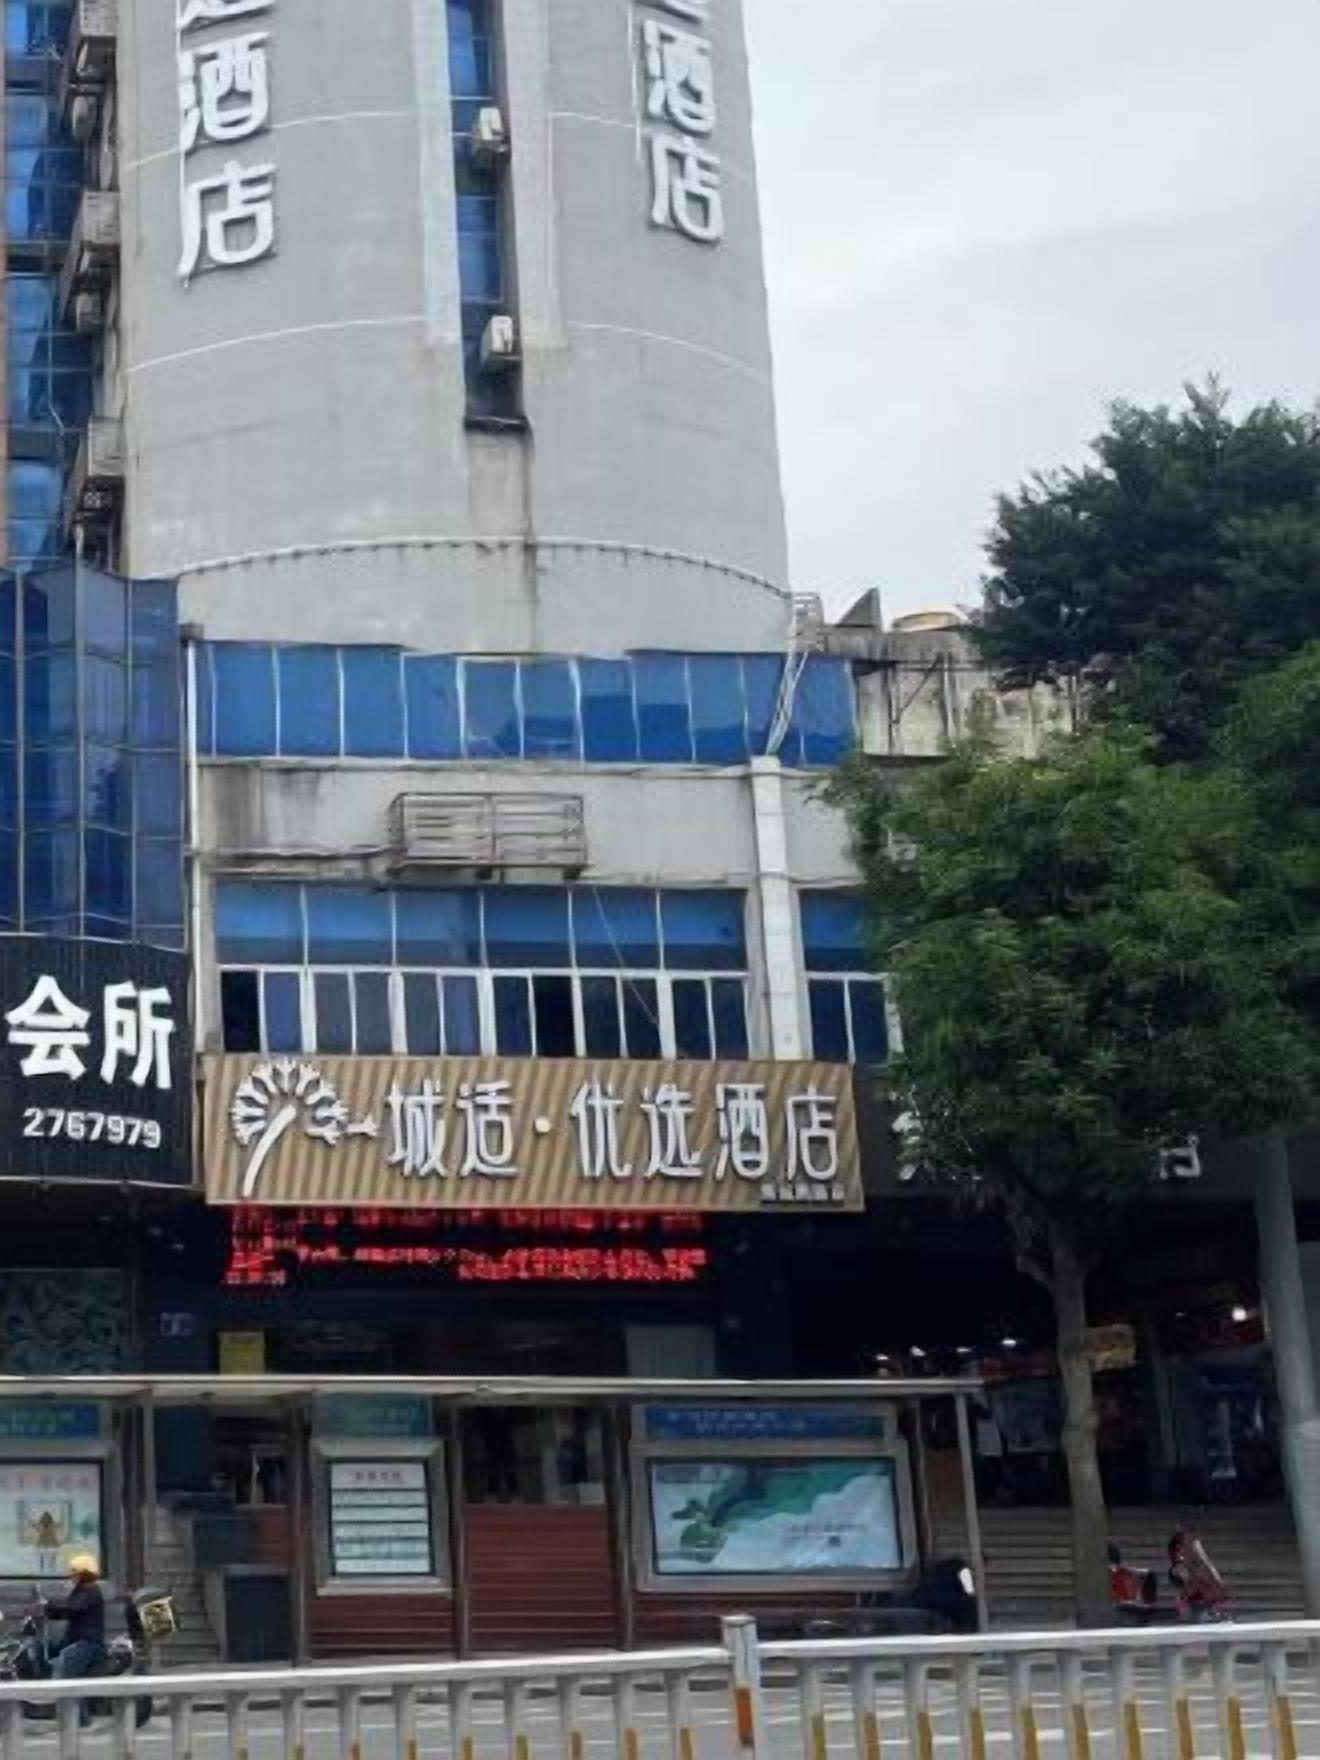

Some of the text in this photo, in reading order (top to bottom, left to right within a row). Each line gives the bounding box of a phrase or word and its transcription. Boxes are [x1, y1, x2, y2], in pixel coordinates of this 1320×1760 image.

[633, 0, 724, 242] 酒店
[23, 1107, 161, 1148] 2767979
[388, 1079, 838, 1180] 城适·优选酒店
